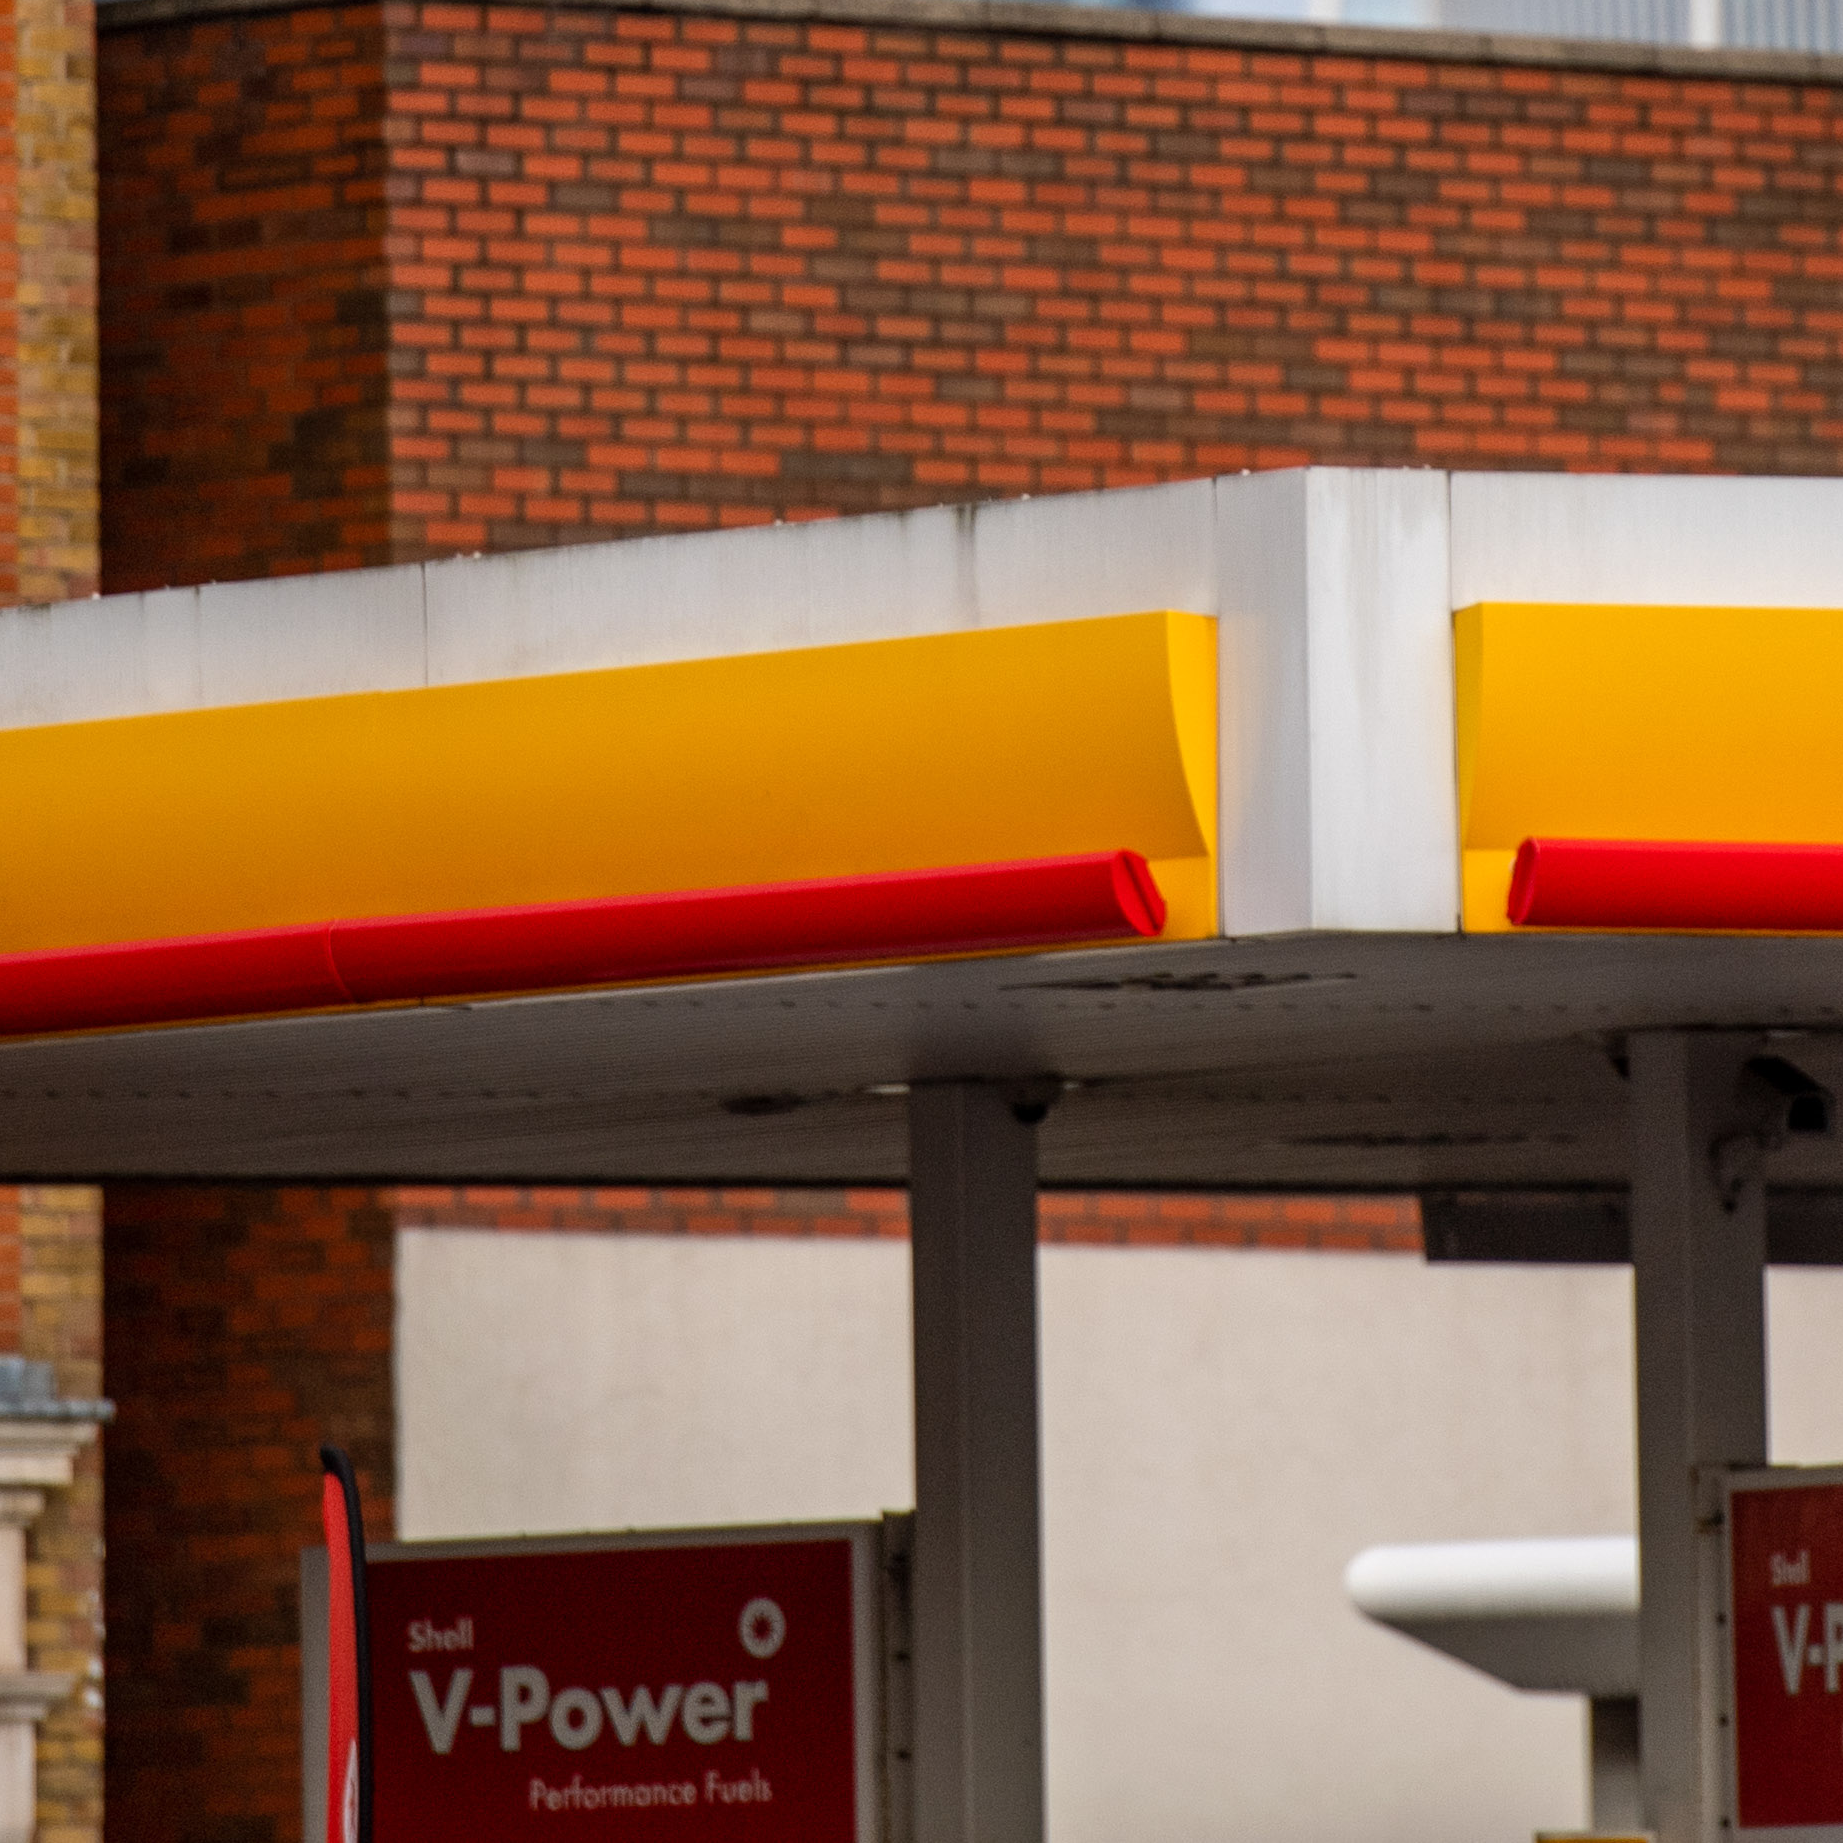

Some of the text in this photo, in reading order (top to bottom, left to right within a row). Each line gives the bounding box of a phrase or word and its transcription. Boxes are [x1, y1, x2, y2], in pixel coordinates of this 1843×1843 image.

[1770, 1549, 1810, 1587] Shell
[407, 1617, 474, 1652] Shell
[409, 1664, 769, 1755] V-Power
[529, 1768, 772, 1811] Performance Fuels
